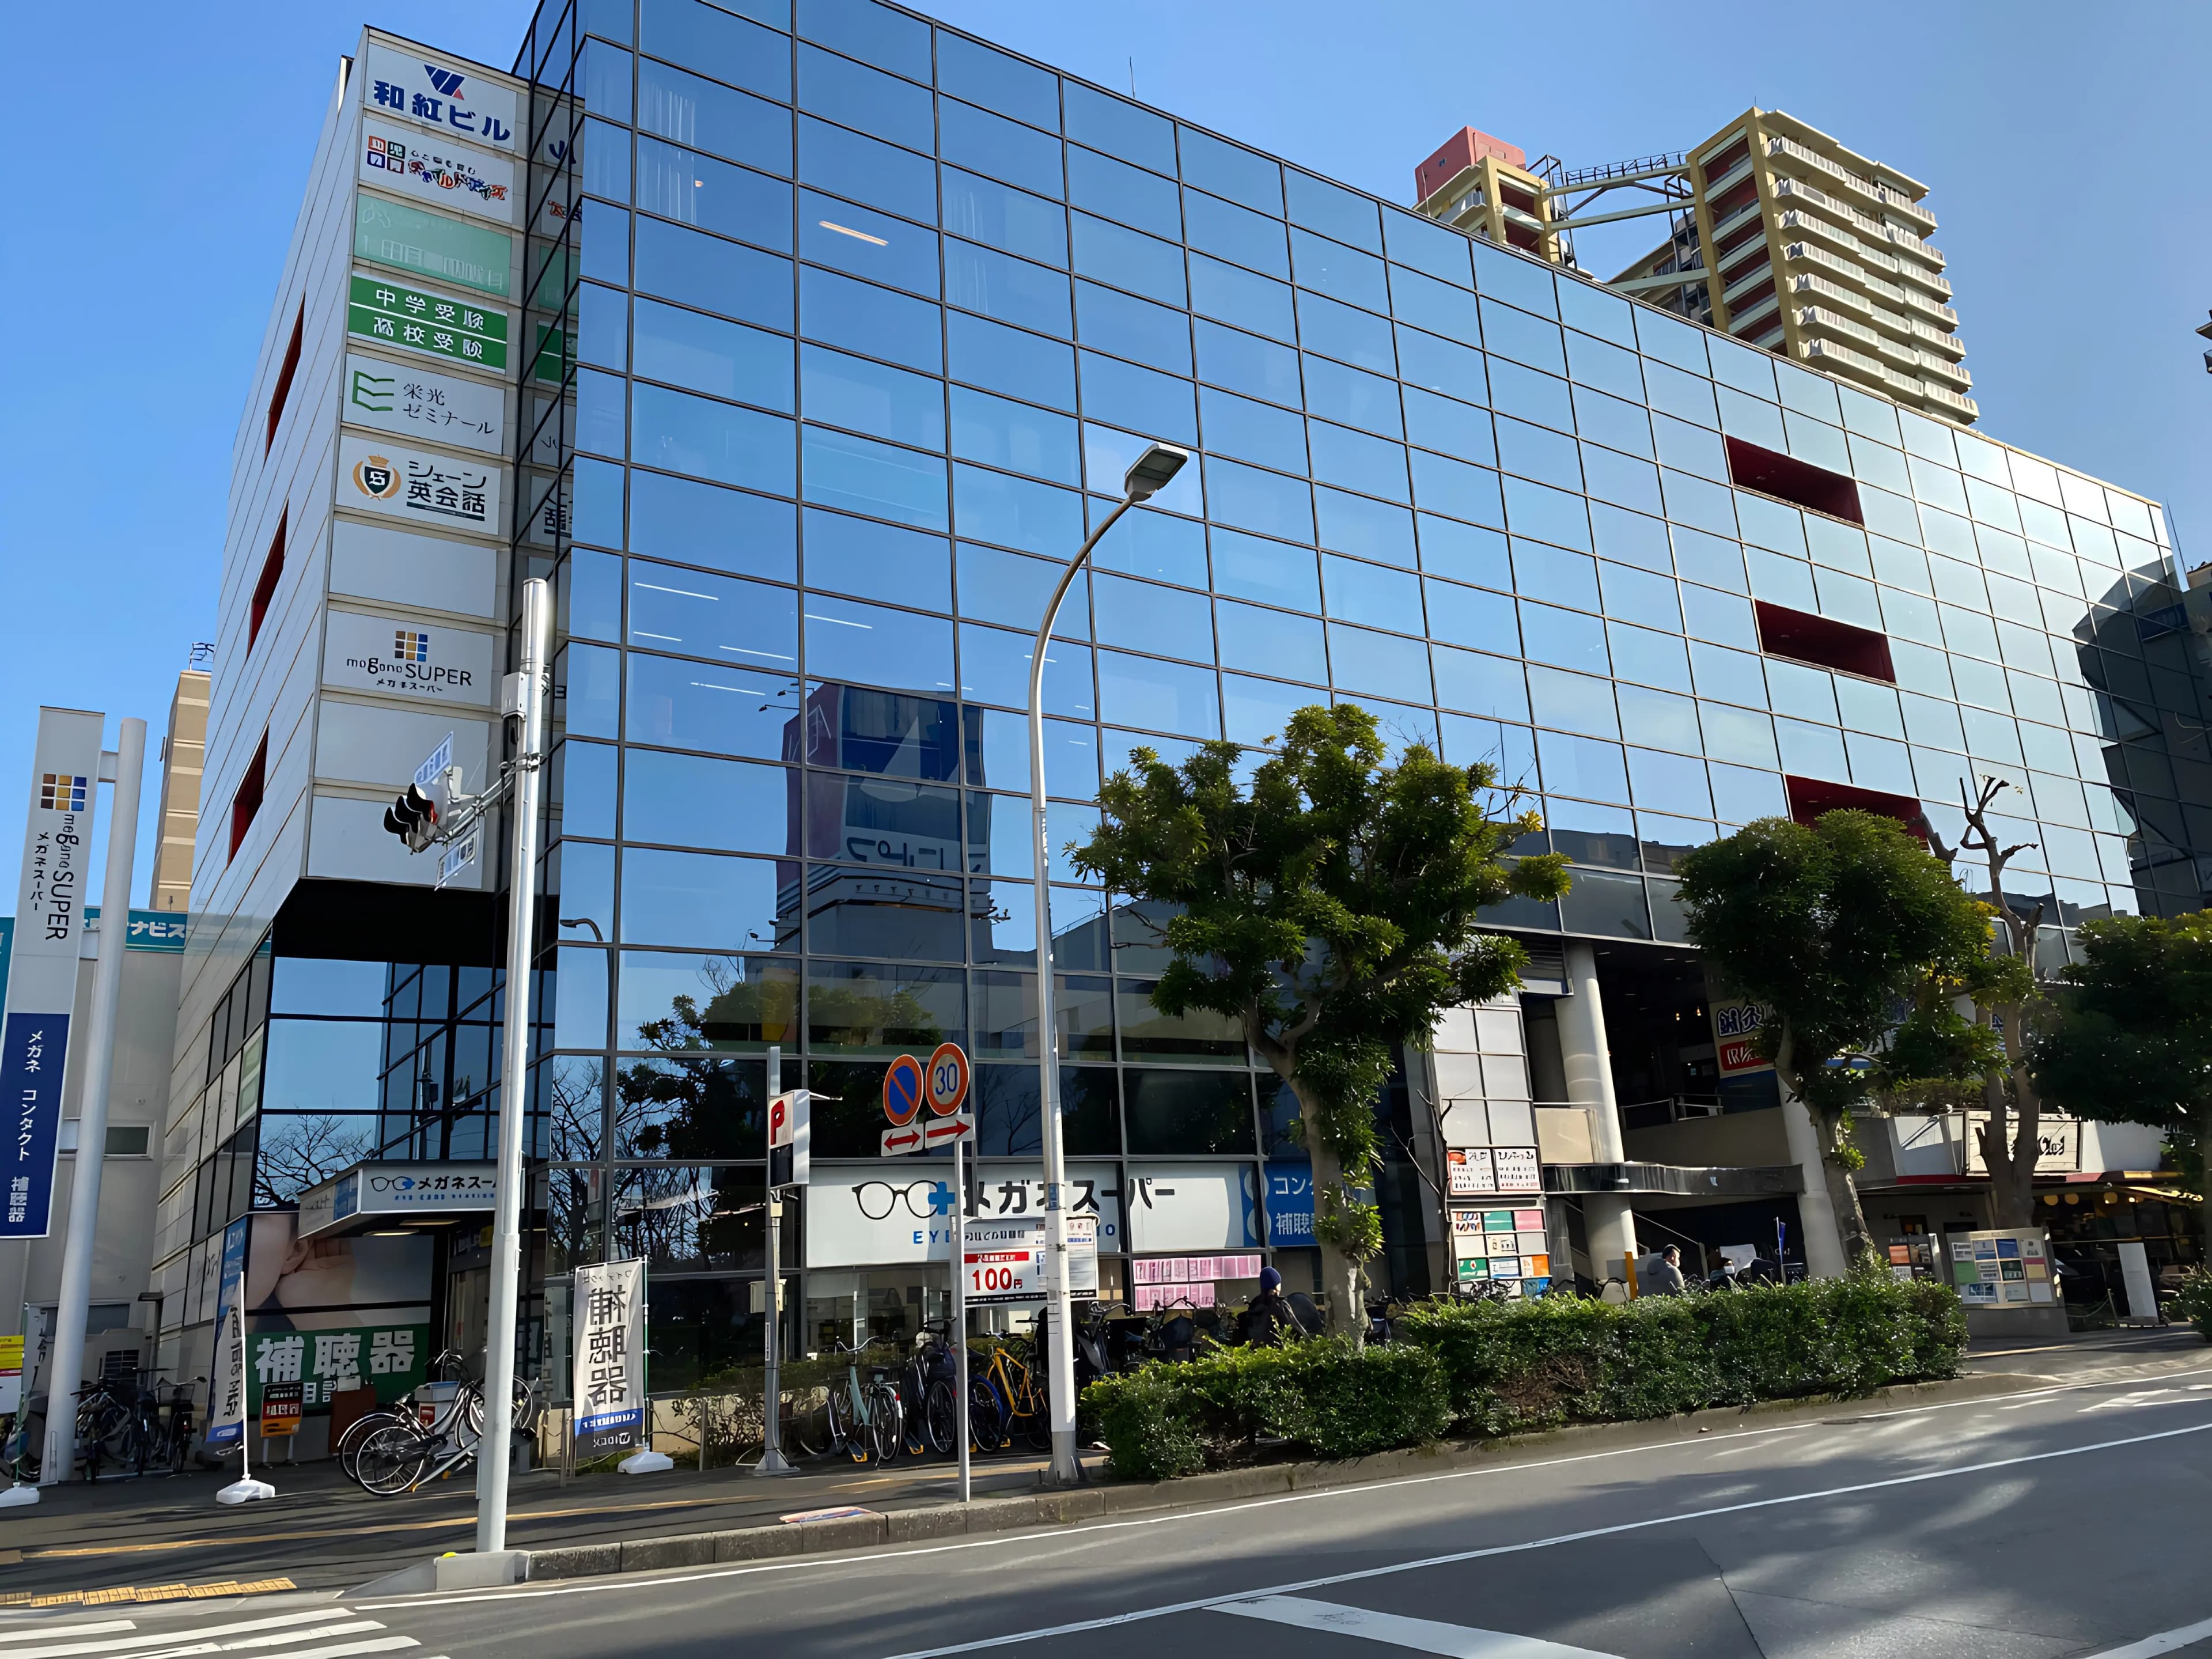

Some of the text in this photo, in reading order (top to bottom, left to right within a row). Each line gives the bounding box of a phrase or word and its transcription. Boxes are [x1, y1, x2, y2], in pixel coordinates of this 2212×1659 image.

[373, 79, 511, 141] 和紅ビル
[376, 288, 484, 331] 中学受験
[373, 317, 483, 360] 高校受験
[403, 382, 445, 407] 栄光
[403, 403, 495, 435] ゼミナール
[408, 461, 487, 489] シェーン
[407, 479, 486, 514] 英会話
[30, 831, 50, 911] メガネスーパー
[24, 1030, 44, 1073] メガネ
[934, 1062, 959, 1096] 30
[18, 1089, 37, 1162] コンタクト
[770, 1099, 785, 1146] P
[418, 1176, 497, 1190] メガネスー
[1274, 1177, 1313, 1195] コン
[1276, 1213, 1315, 1235] 補聴
[255, 1330, 415, 1384] 補聴器
